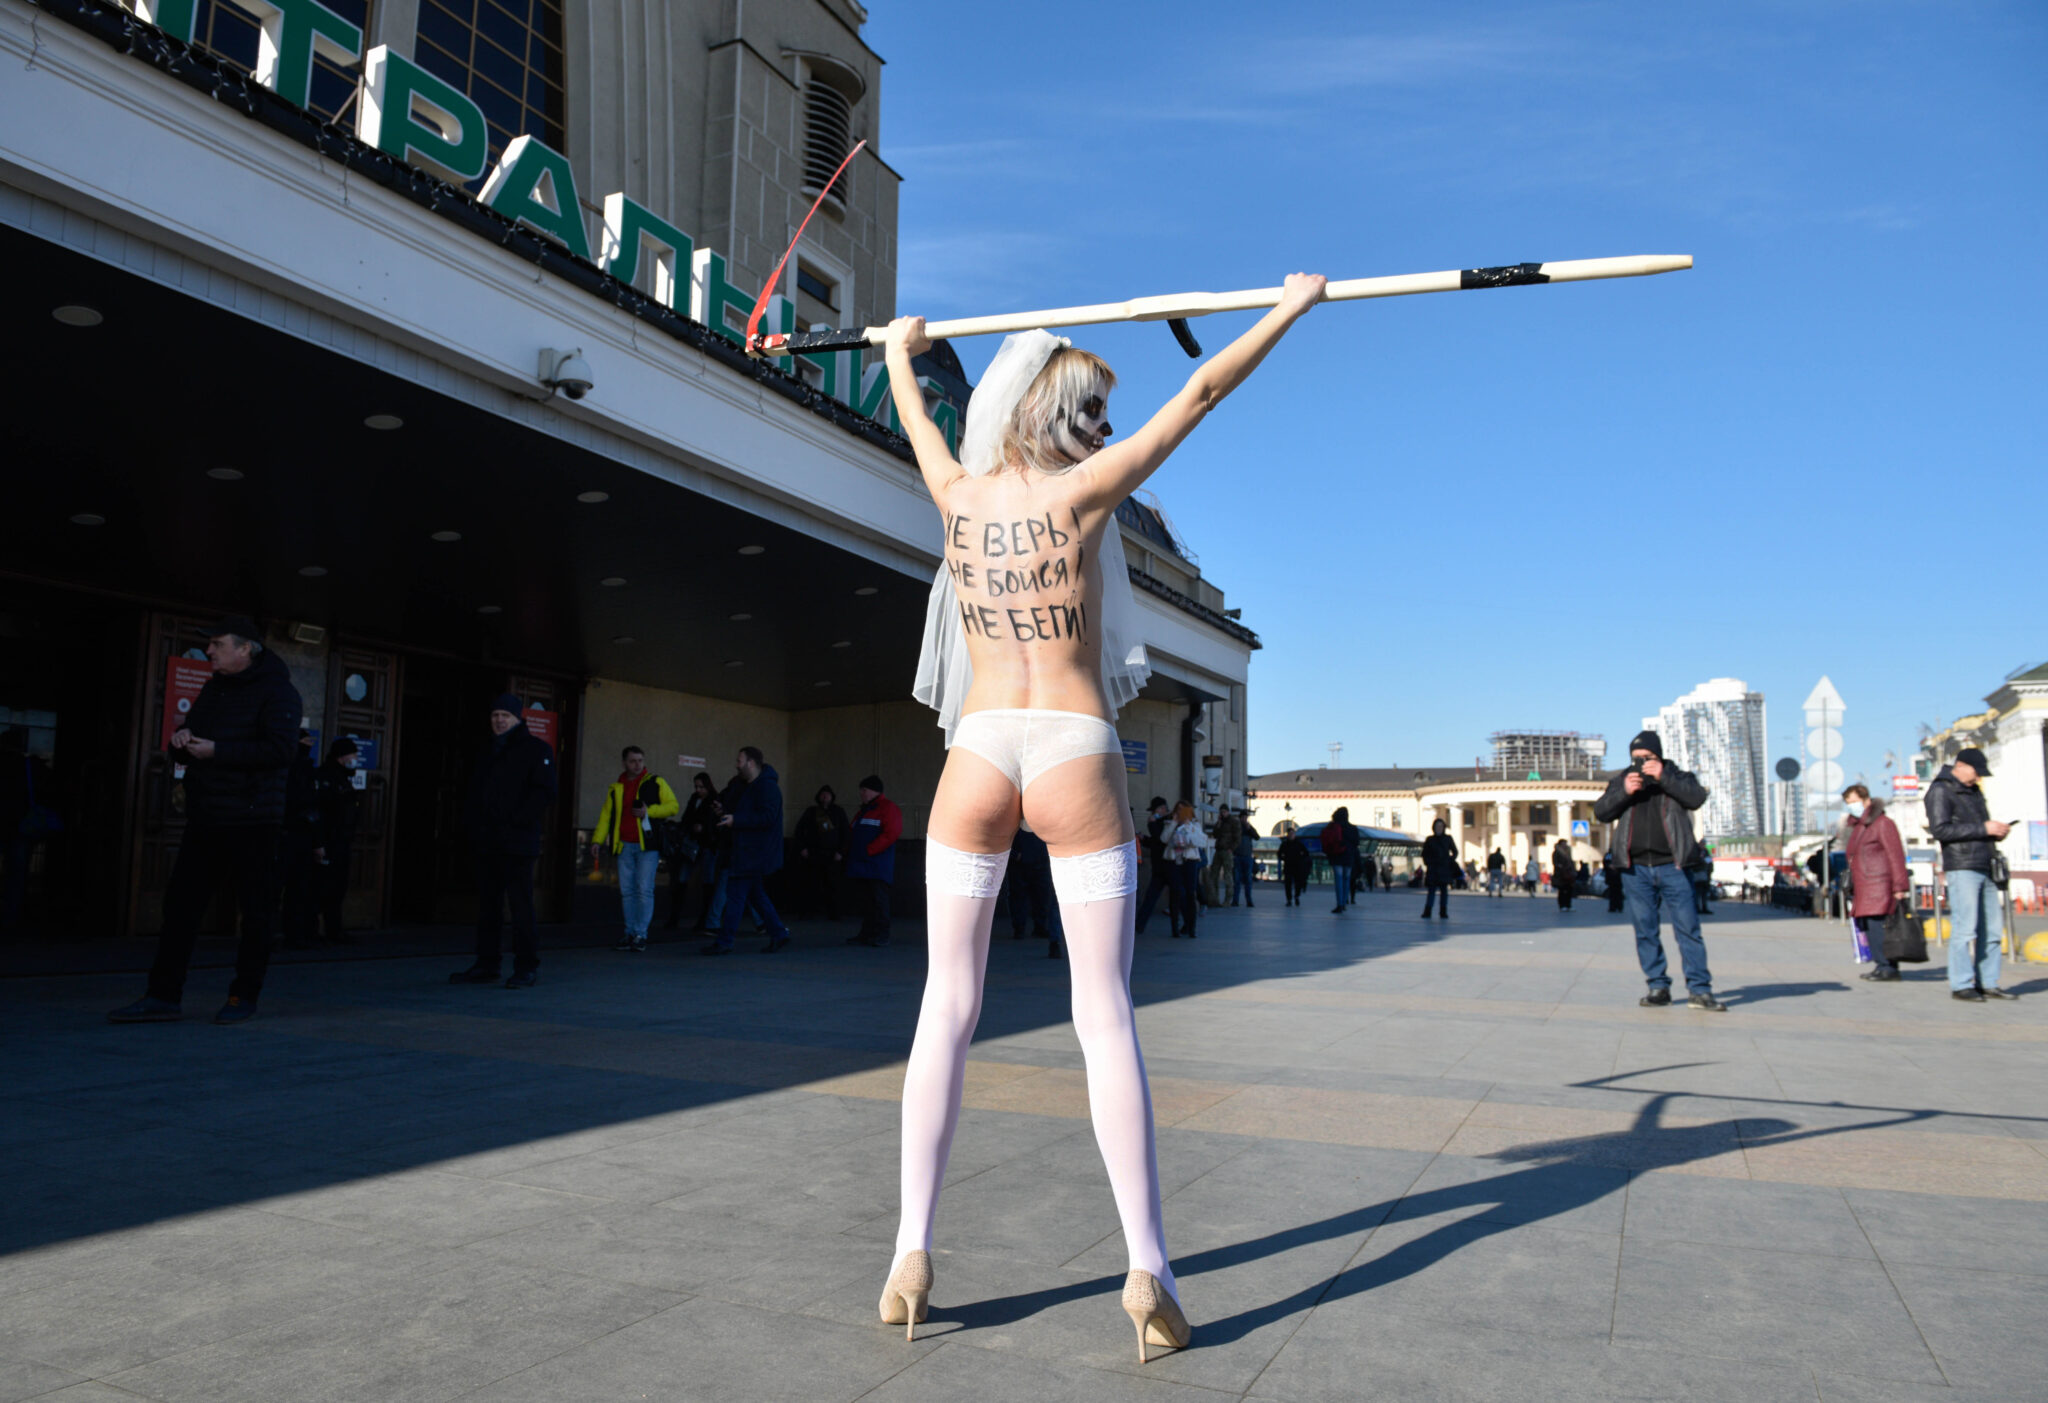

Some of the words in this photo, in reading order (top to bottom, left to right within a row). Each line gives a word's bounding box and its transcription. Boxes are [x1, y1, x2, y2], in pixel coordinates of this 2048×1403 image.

[152, 0, 958, 457] ТРАЛЬНИЙ
[984, 507, 1082, 558] ВЕРЬ!
[947, 558, 977, 588] НЕ
[986, 546, 1083, 597] БОЙСЯ!
[960, 600, 1004, 639] НЕ
